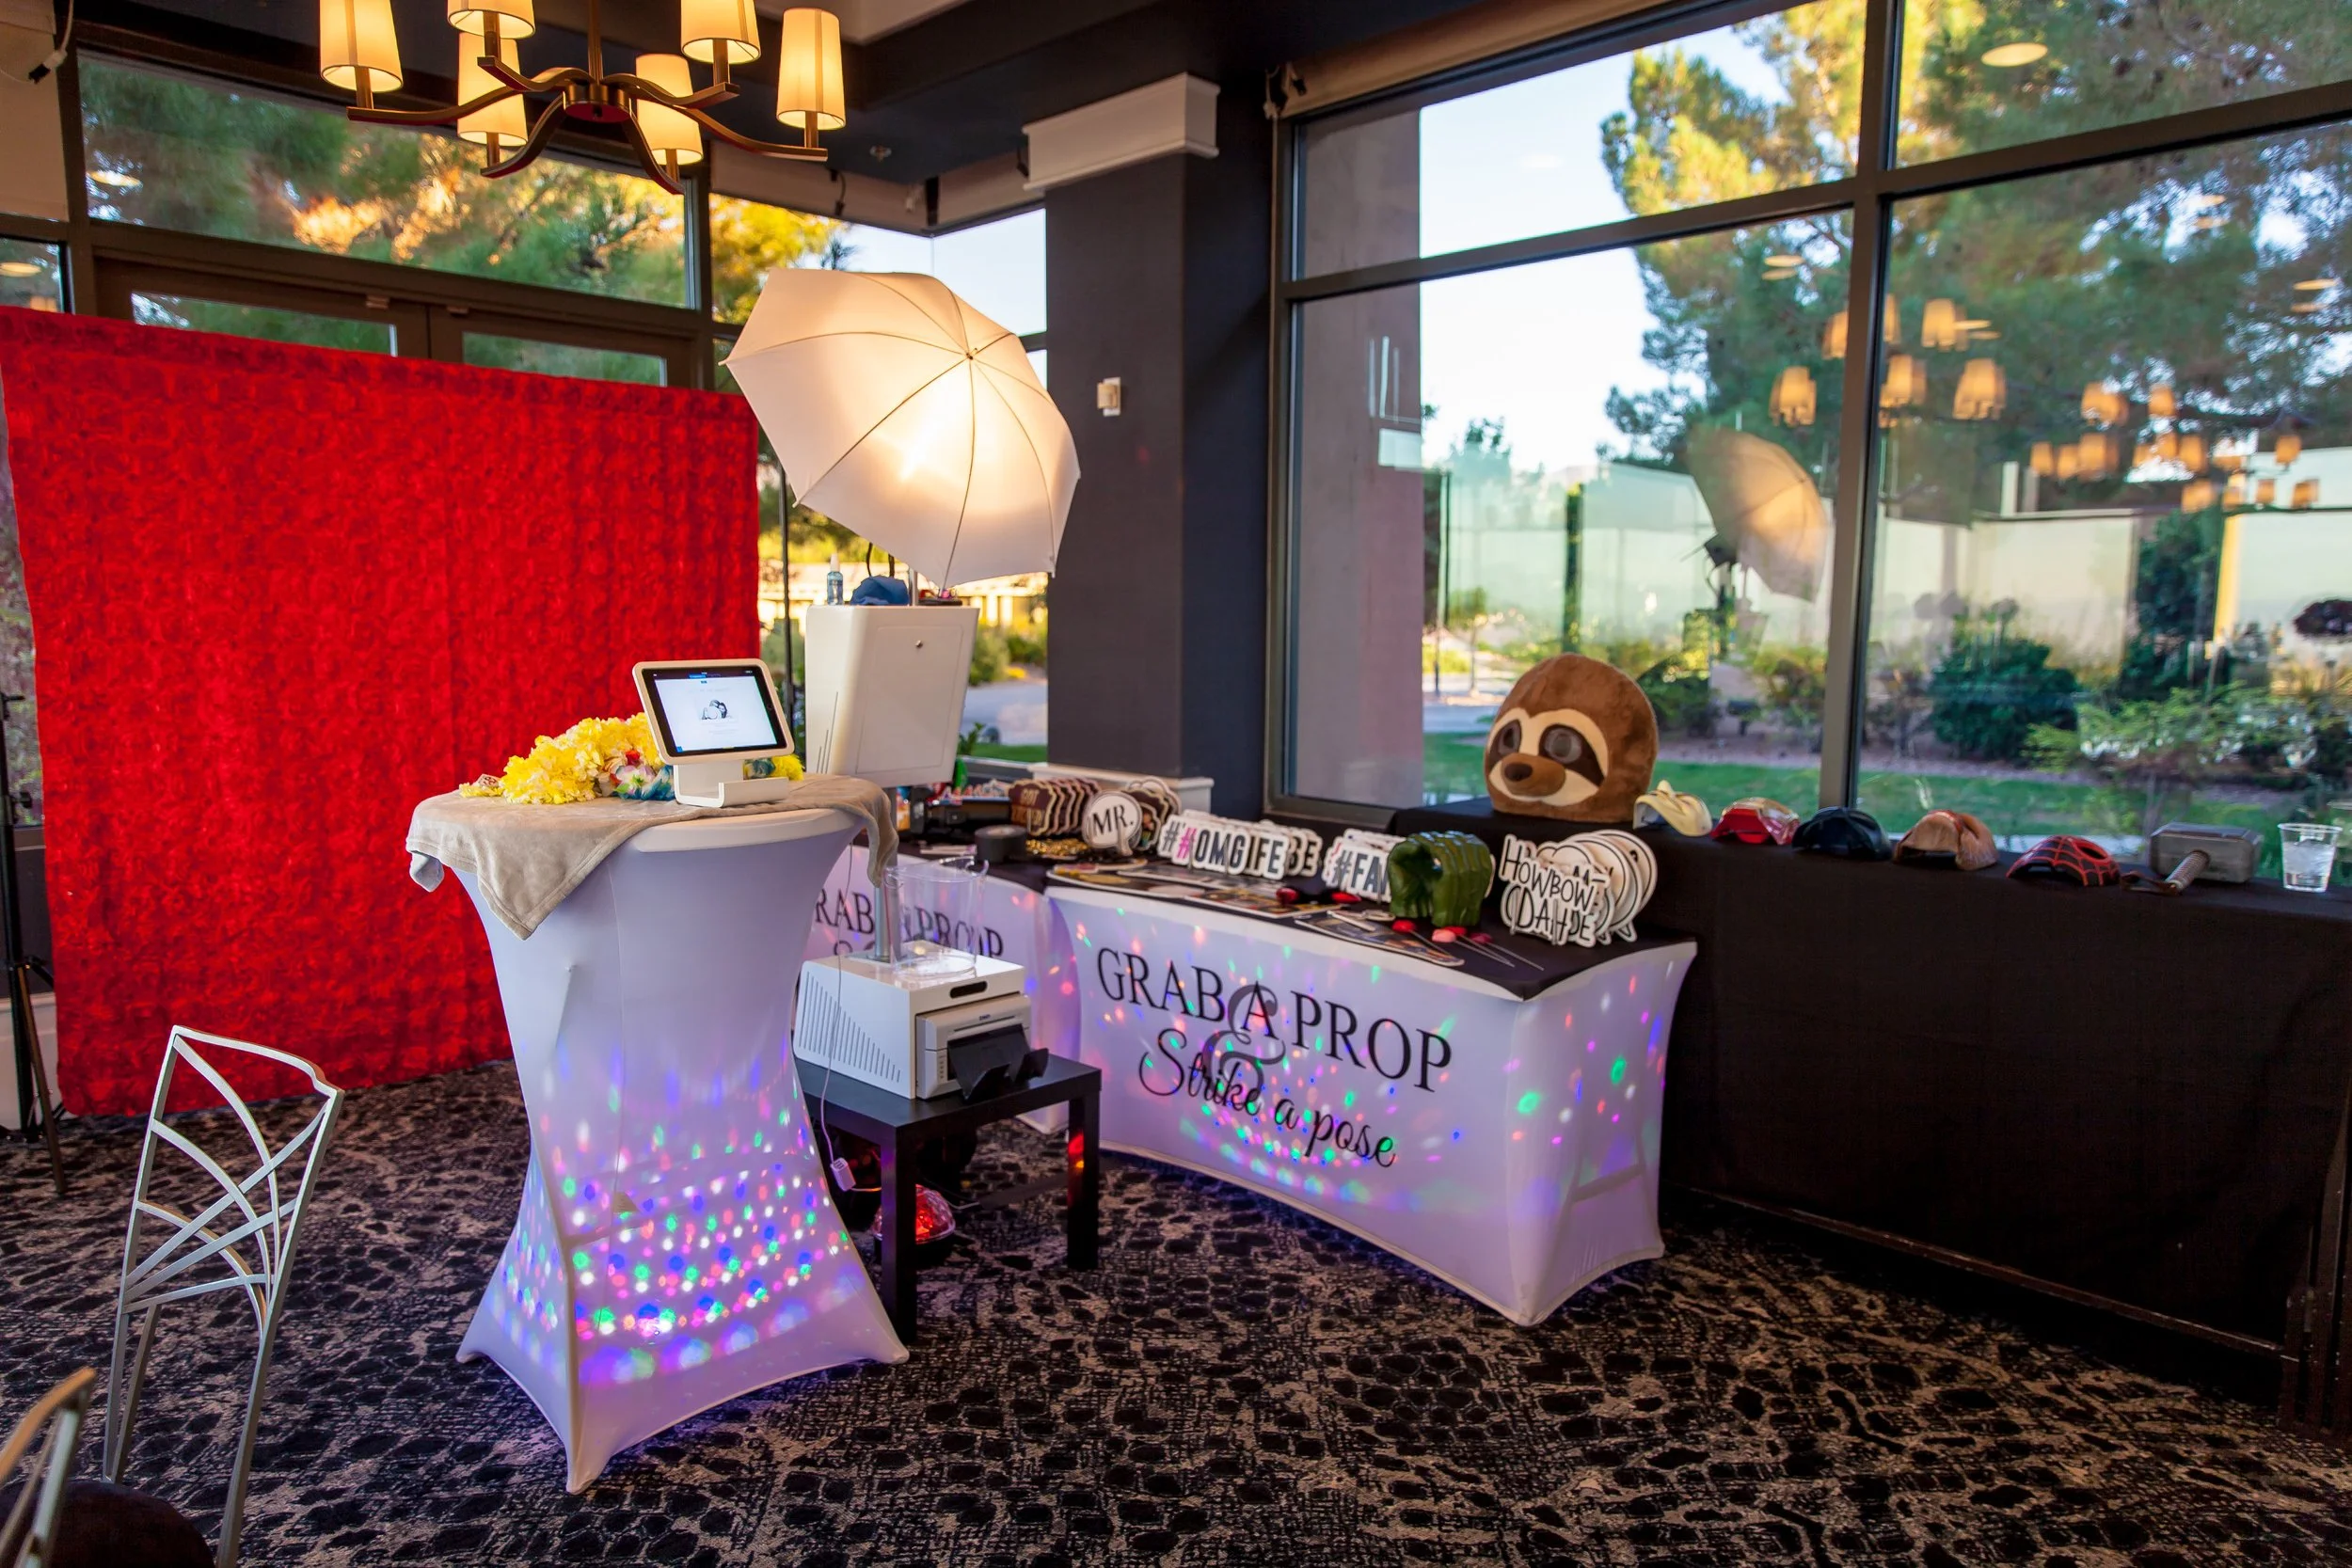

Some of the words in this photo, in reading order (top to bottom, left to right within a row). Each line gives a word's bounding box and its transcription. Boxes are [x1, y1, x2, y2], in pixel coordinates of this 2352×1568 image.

[1092, 804, 1134, 836] MR.
[1176, 827, 1246, 868] #OMG
[815, 888, 874, 935] RAB
[1097, 947, 1225, 1022] GRAB
[1240, 980, 1279, 1040] A
[1290, 990, 1452, 1093] PROP
[1138, 1028, 1262, 1117] Strike
[1274, 1098, 1300, 1131] a
[1304, 1110, 1397, 1168] pose
